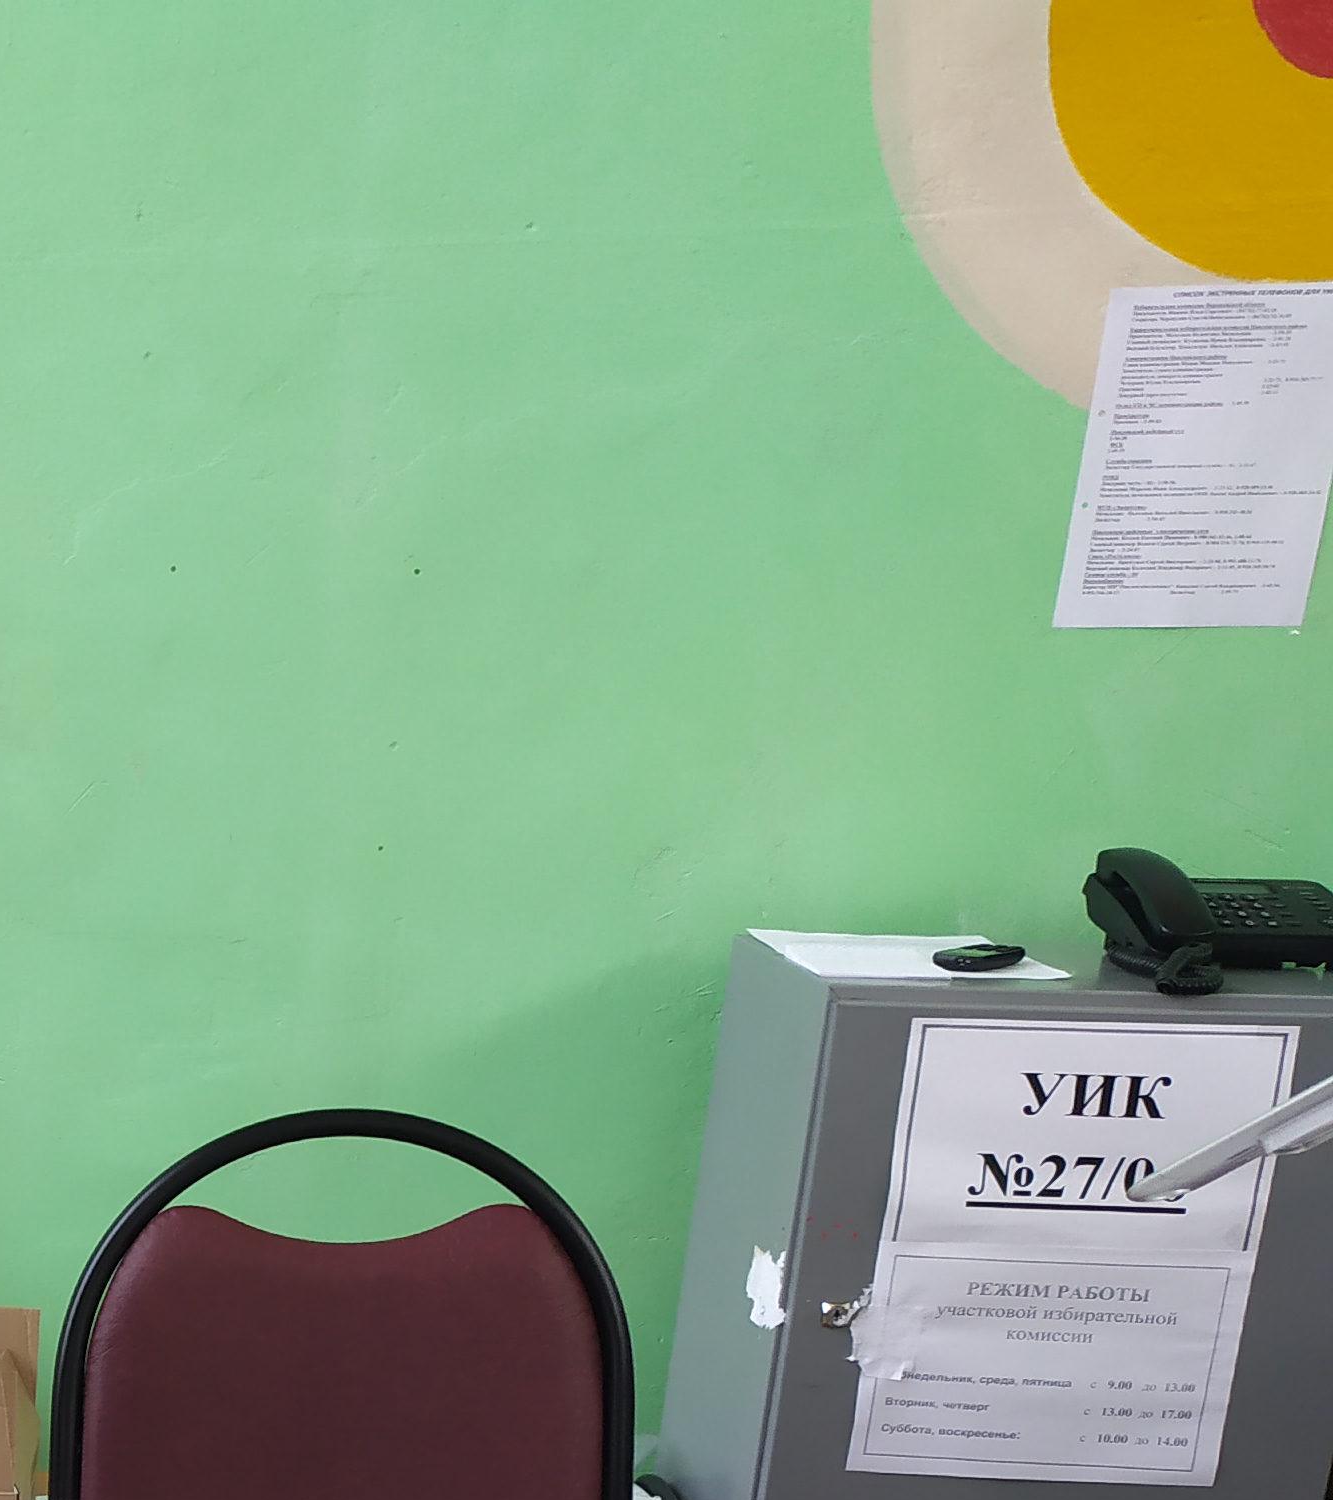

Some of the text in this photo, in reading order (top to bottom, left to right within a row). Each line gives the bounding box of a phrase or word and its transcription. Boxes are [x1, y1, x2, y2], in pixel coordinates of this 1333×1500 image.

[1020, 1072, 1172, 1119] УИК
[966, 1152, 1186, 1203] №27/0
[967, 1281, 1151, 1303] РЕЖИМ РАБОТЫ
[934, 1303, 1178, 1327] участковой избирательной
[1005, 1329, 1094, 1344] комиссии
[979, 1376, 1019, 1388] среда,
[1022, 1378, 1072, 1388] пятница
[1090, 1381, 1097, 1389] с
[1107, 1380, 1133, 1391] 9.00
[1141, 1383, 1157, 1393] до
[1164, 1382, 1196, 1393] 13.00
[885, 1396, 1192, 1420] Вторник, четверг с 13.00 до 17.00
[881, 1423, 936, 1437] Суббота,
[938, 1427, 1021, 1440] воскресенье:
[1097, 1433, 1128, 1444] 10.00
[1134, 1436, 1150, 1446] до
[1156, 1436, 1188, 1447] 14.00
